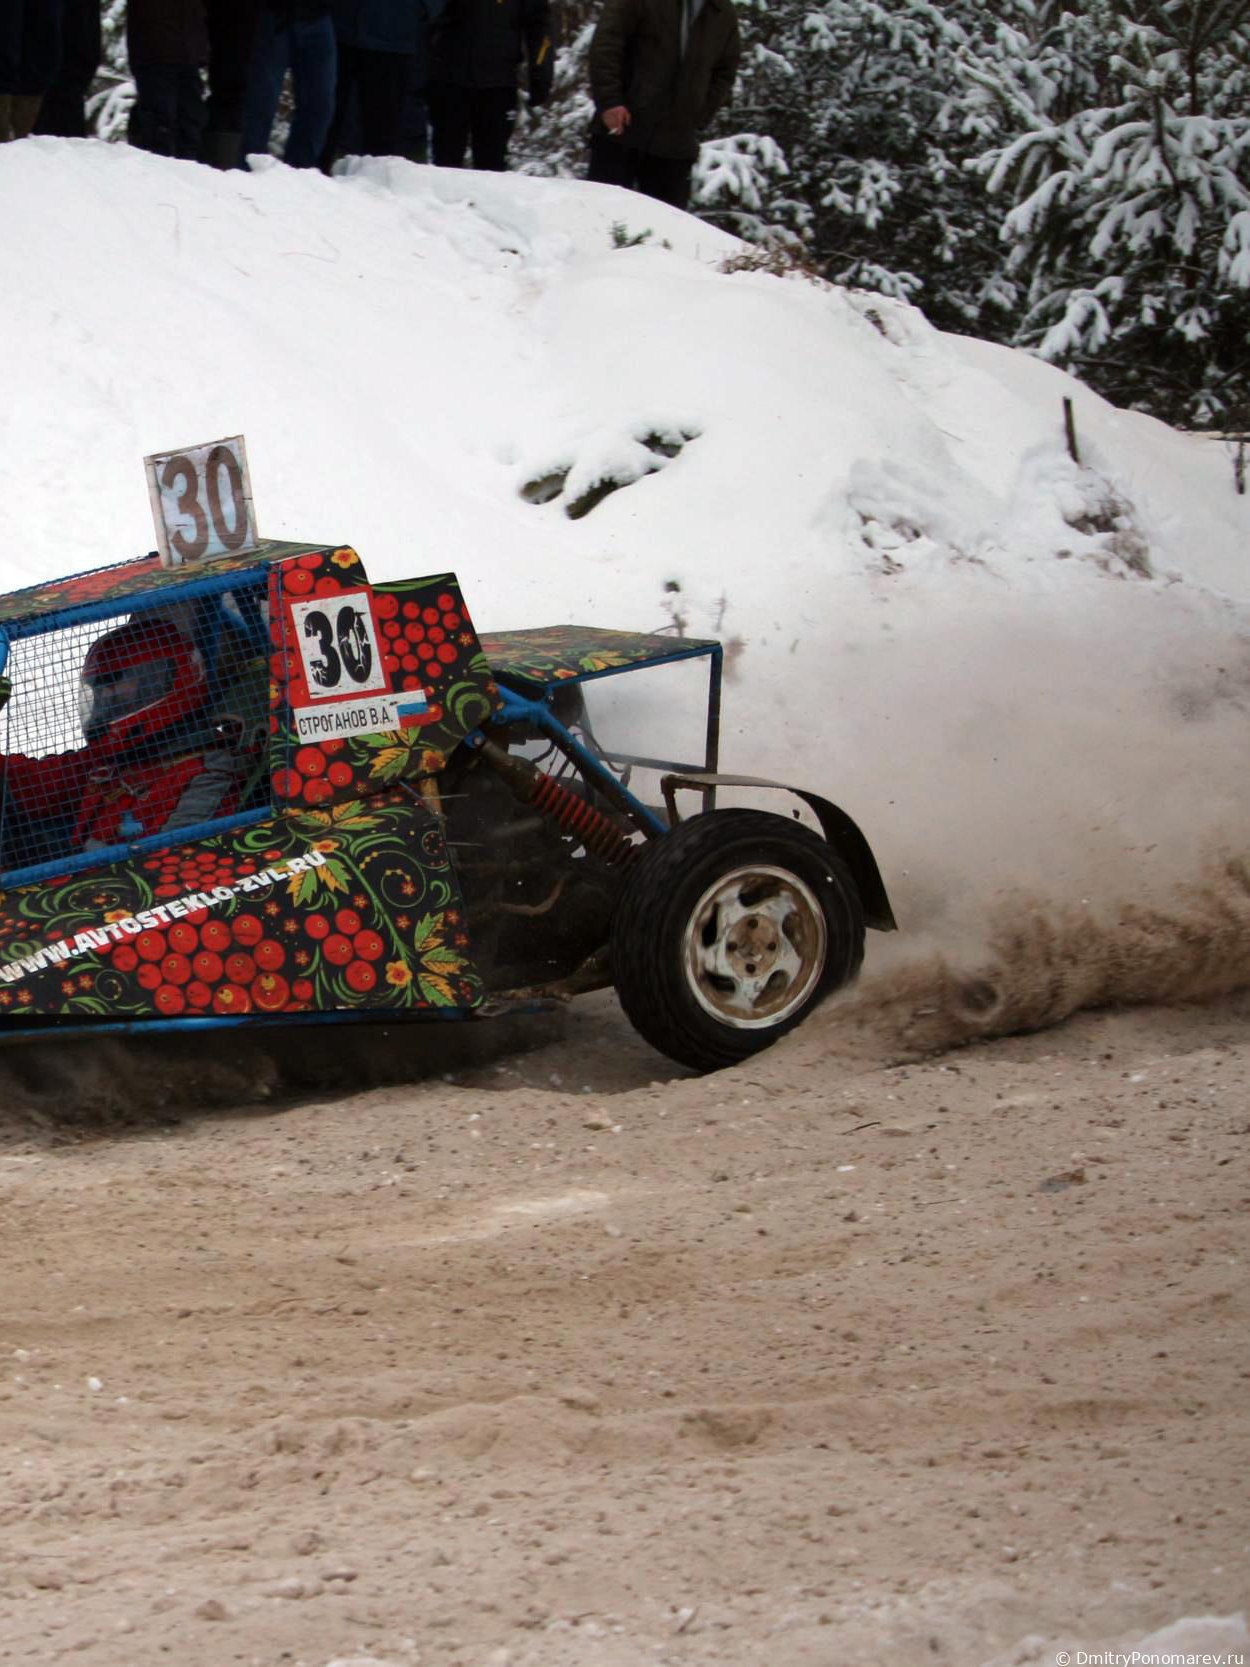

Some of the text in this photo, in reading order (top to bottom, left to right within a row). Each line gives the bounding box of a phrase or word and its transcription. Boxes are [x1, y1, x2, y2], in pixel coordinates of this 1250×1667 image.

[162, 446, 248, 561] 30
[304, 606, 372, 688] 30
[298, 707, 394, 736] СТРОГАНОВ В.А.
